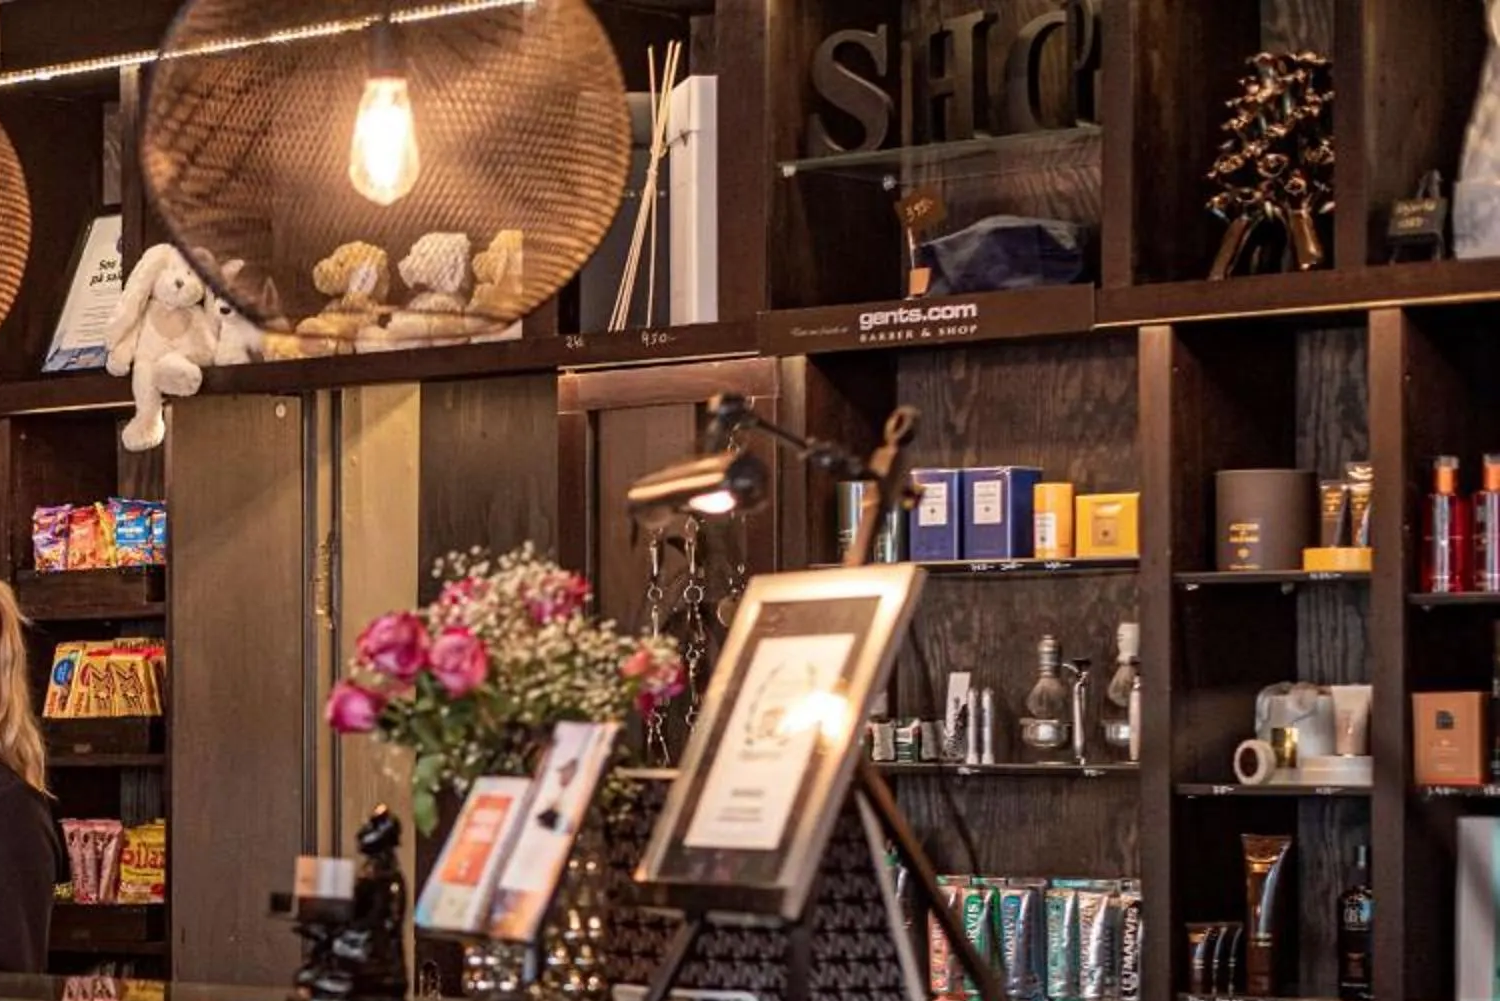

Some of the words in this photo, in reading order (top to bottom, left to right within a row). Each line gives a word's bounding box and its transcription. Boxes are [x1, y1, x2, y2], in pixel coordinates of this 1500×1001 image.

[858, 303, 978, 331] gents.com
[859, 330, 915, 344] BARBER
[920, 327, 932, 338] &
[938, 324, 978, 338] SHOP
[1121, 907, 1138, 970] MARVIS
